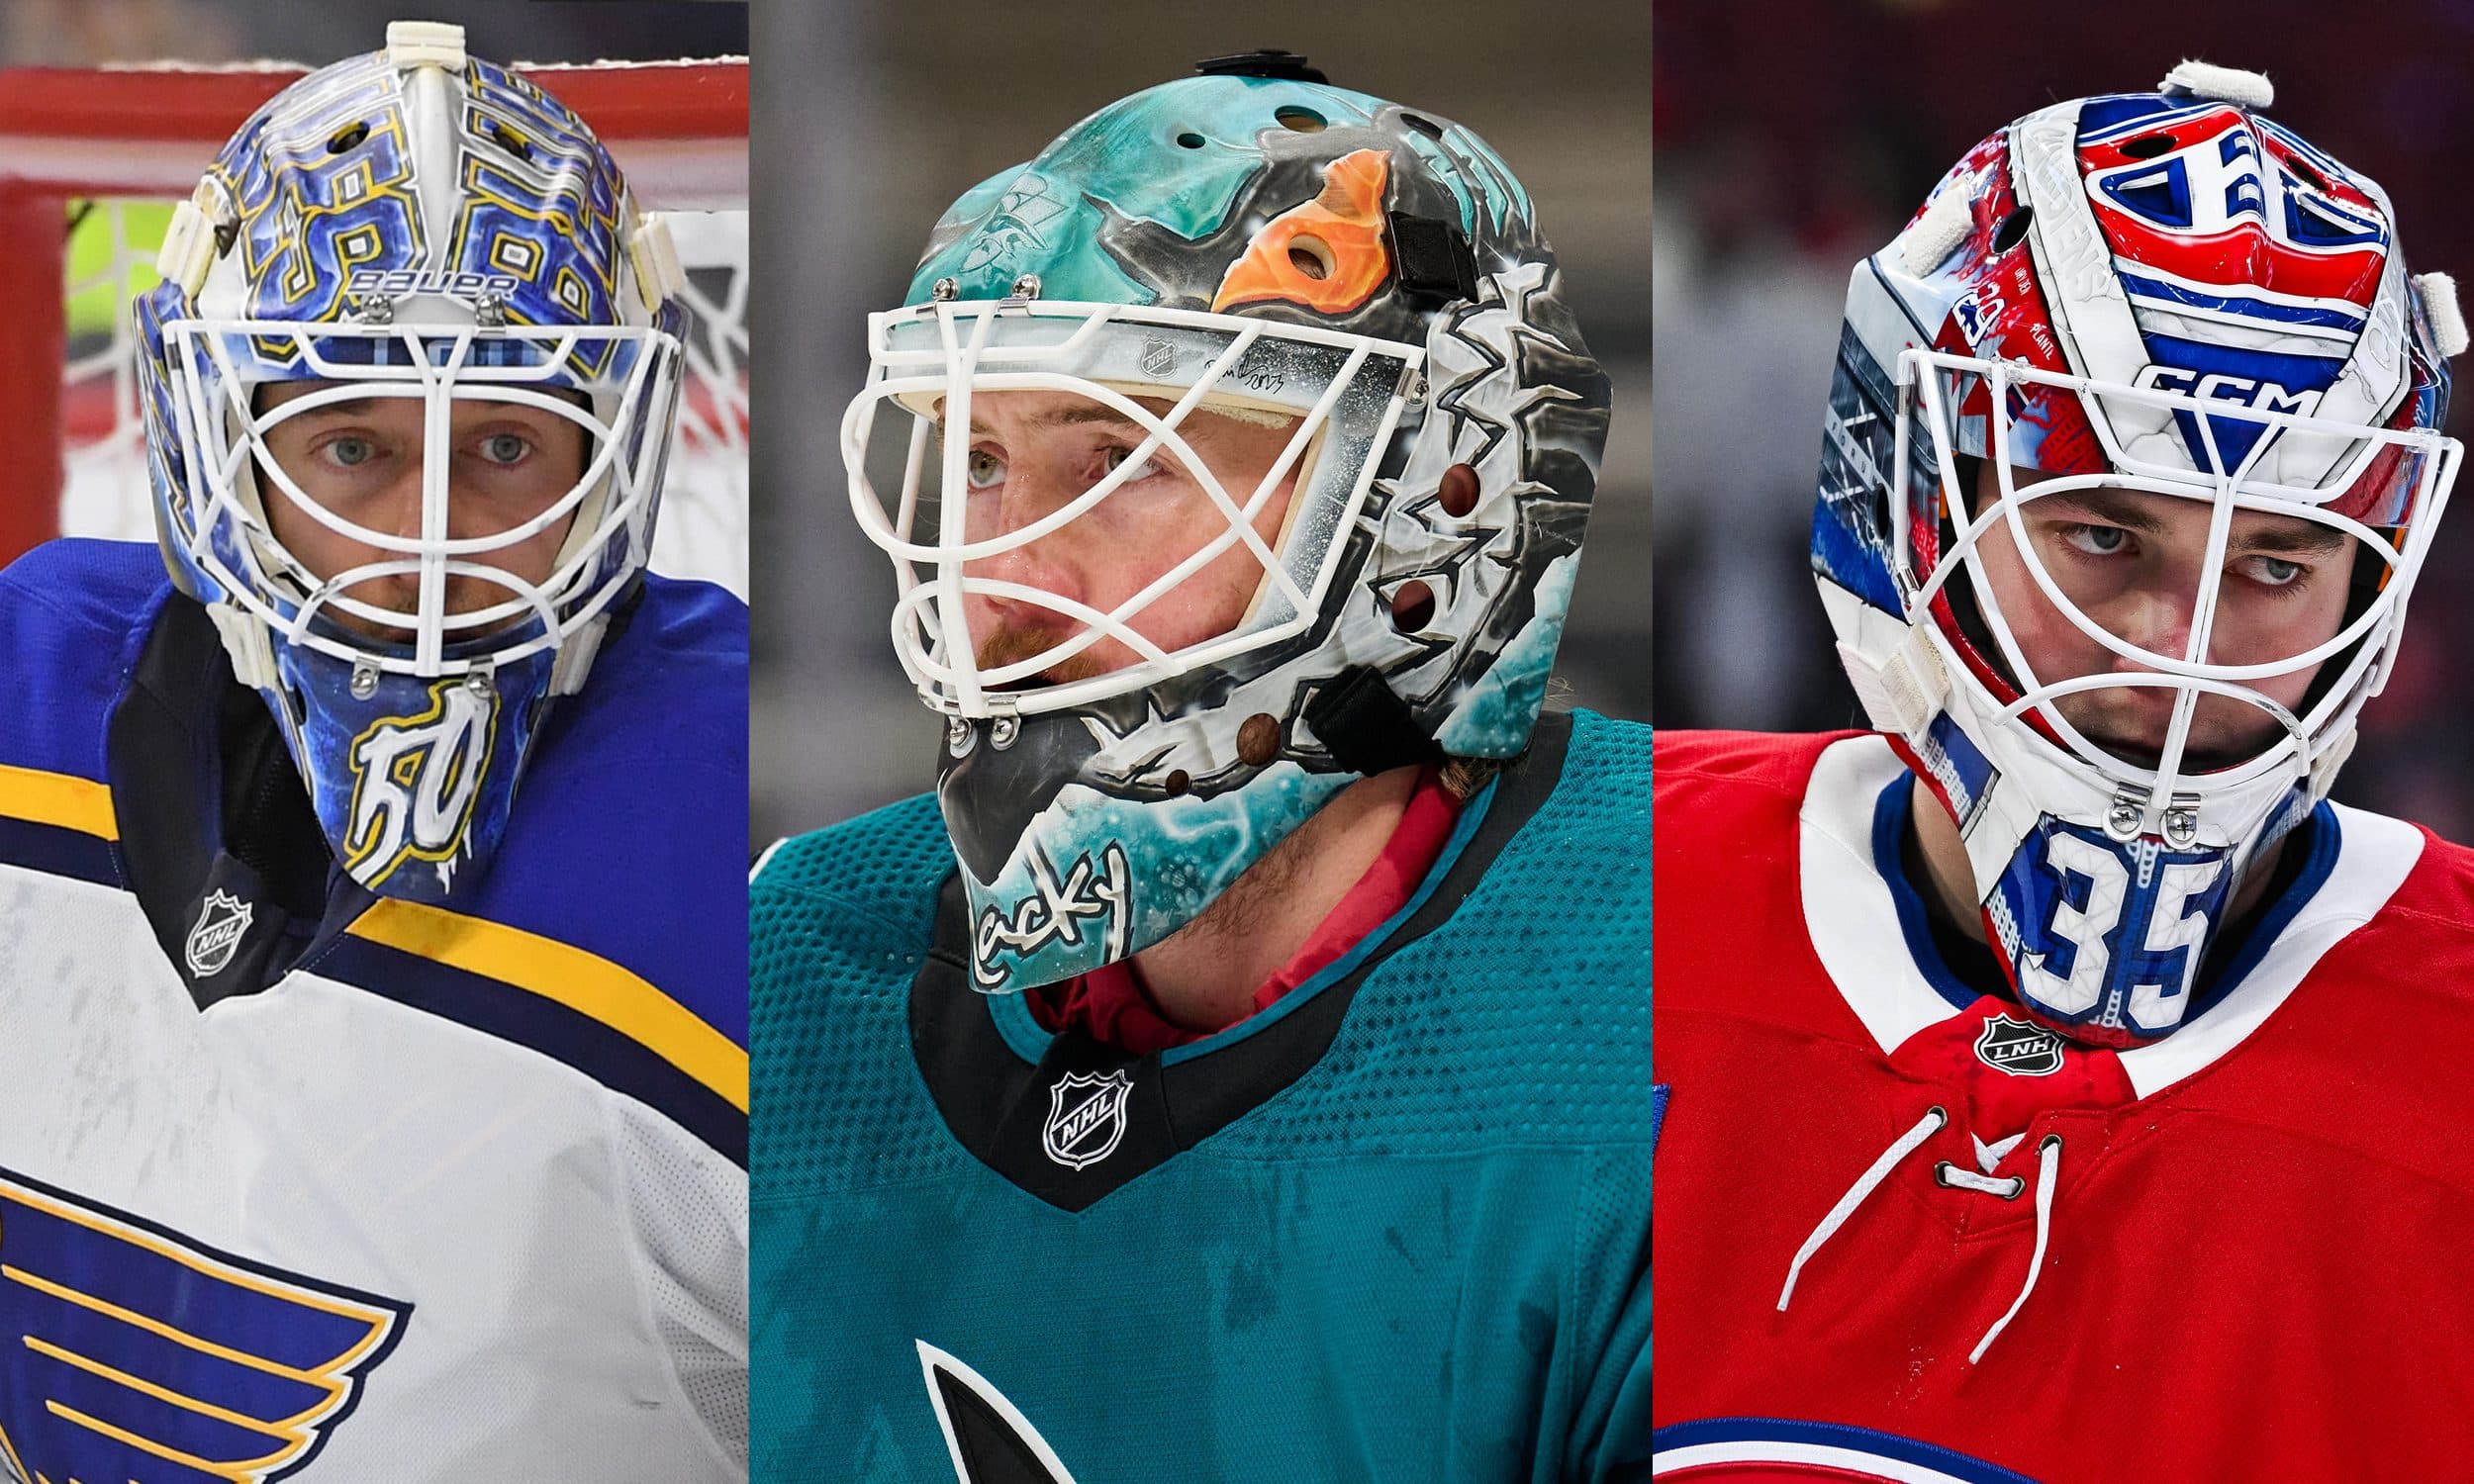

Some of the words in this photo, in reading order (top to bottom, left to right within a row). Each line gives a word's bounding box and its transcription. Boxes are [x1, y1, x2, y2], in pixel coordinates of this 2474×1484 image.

[346, 270, 519, 301] BAUER
[1146, 349, 1174, 370] NHL
[2133, 364, 2326, 418] CCM
[196, 921, 238, 954] NHL
[2020, 830, 2225, 1031] 35
[1993, 1037, 2051, 1060] LNH
[1061, 1093, 1113, 1148] NHL
